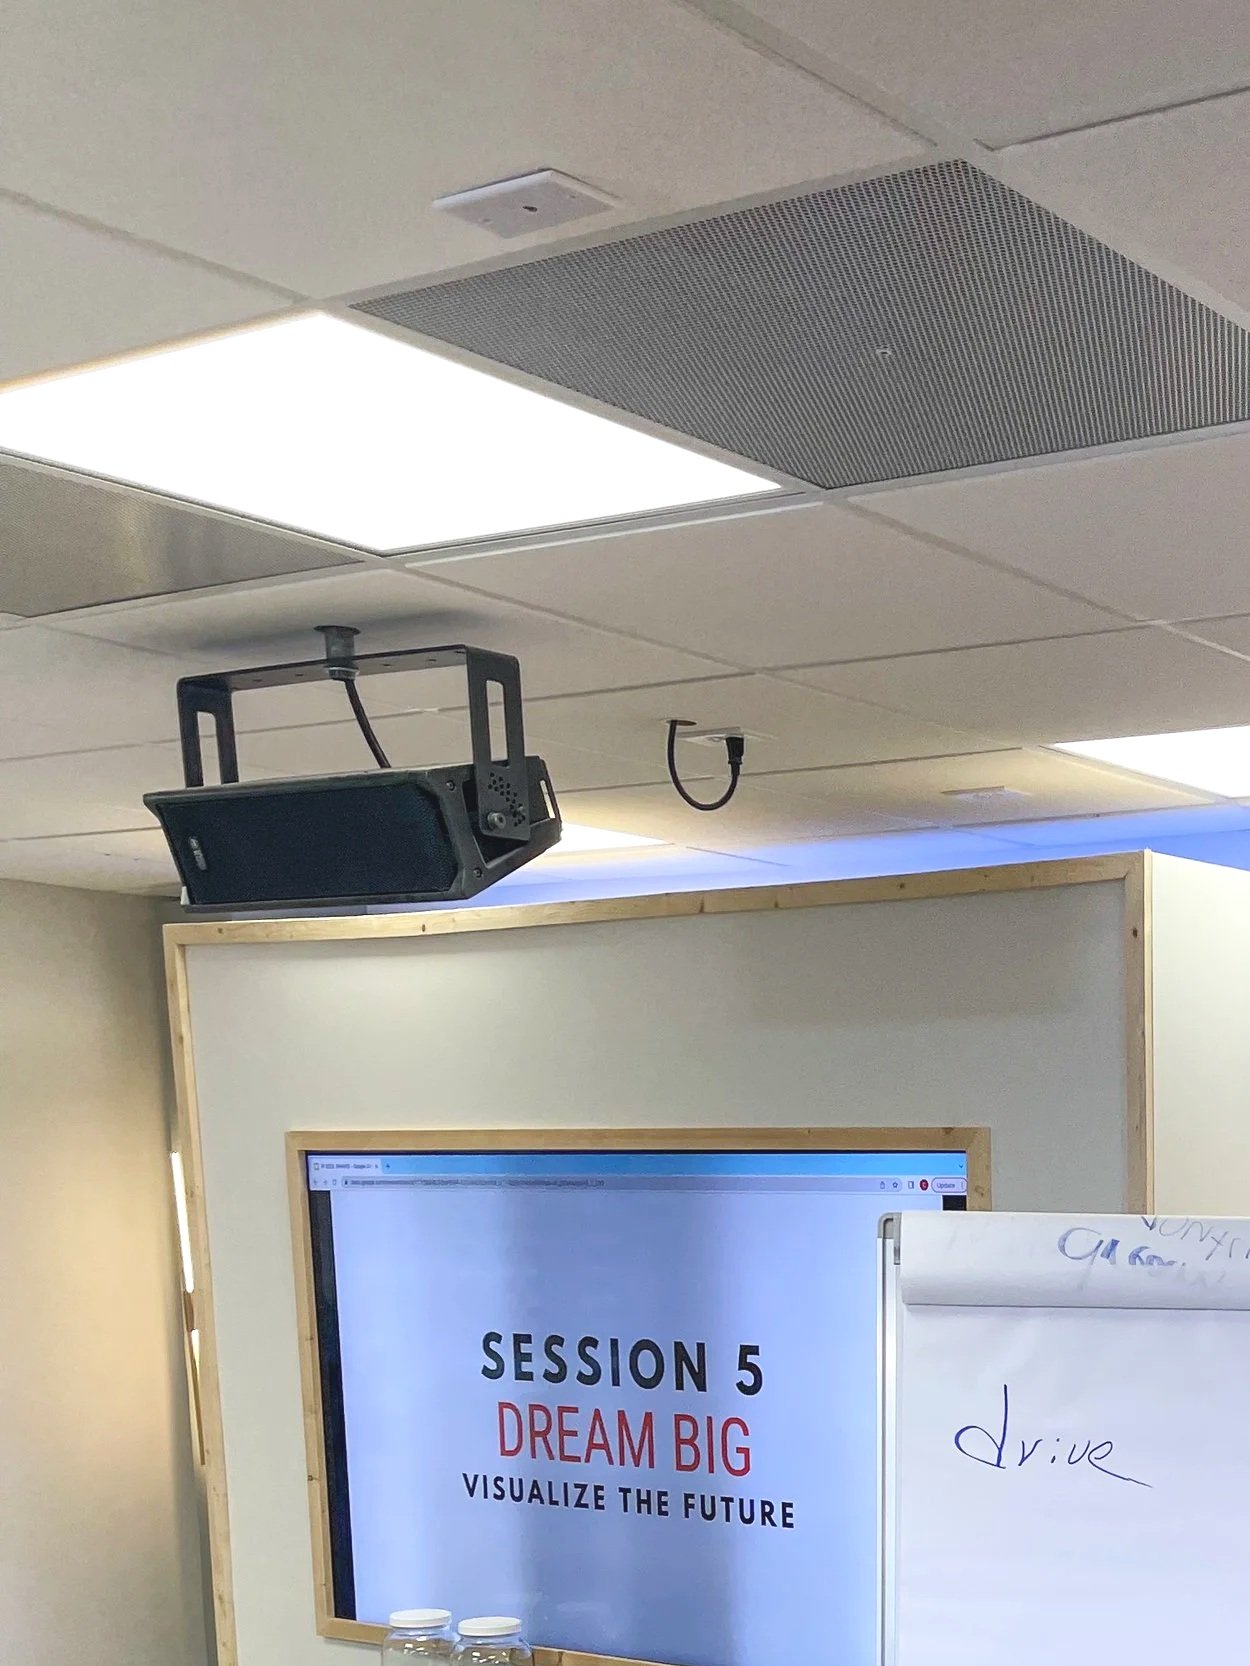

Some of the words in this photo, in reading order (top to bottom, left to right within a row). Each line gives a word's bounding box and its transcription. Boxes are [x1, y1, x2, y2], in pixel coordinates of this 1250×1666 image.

[481, 1331, 707, 1393] SESSION
[735, 1344, 763, 1396] 5
[497, 1401, 655, 1469] DREAM
[674, 1413, 751, 1477] BIG
[954, 1383, 1152, 1489] drive
[462, 1472, 606, 1511] VISUALIZE
[618, 1486, 669, 1517] THE
[683, 1492, 795, 1529] FUTURE
